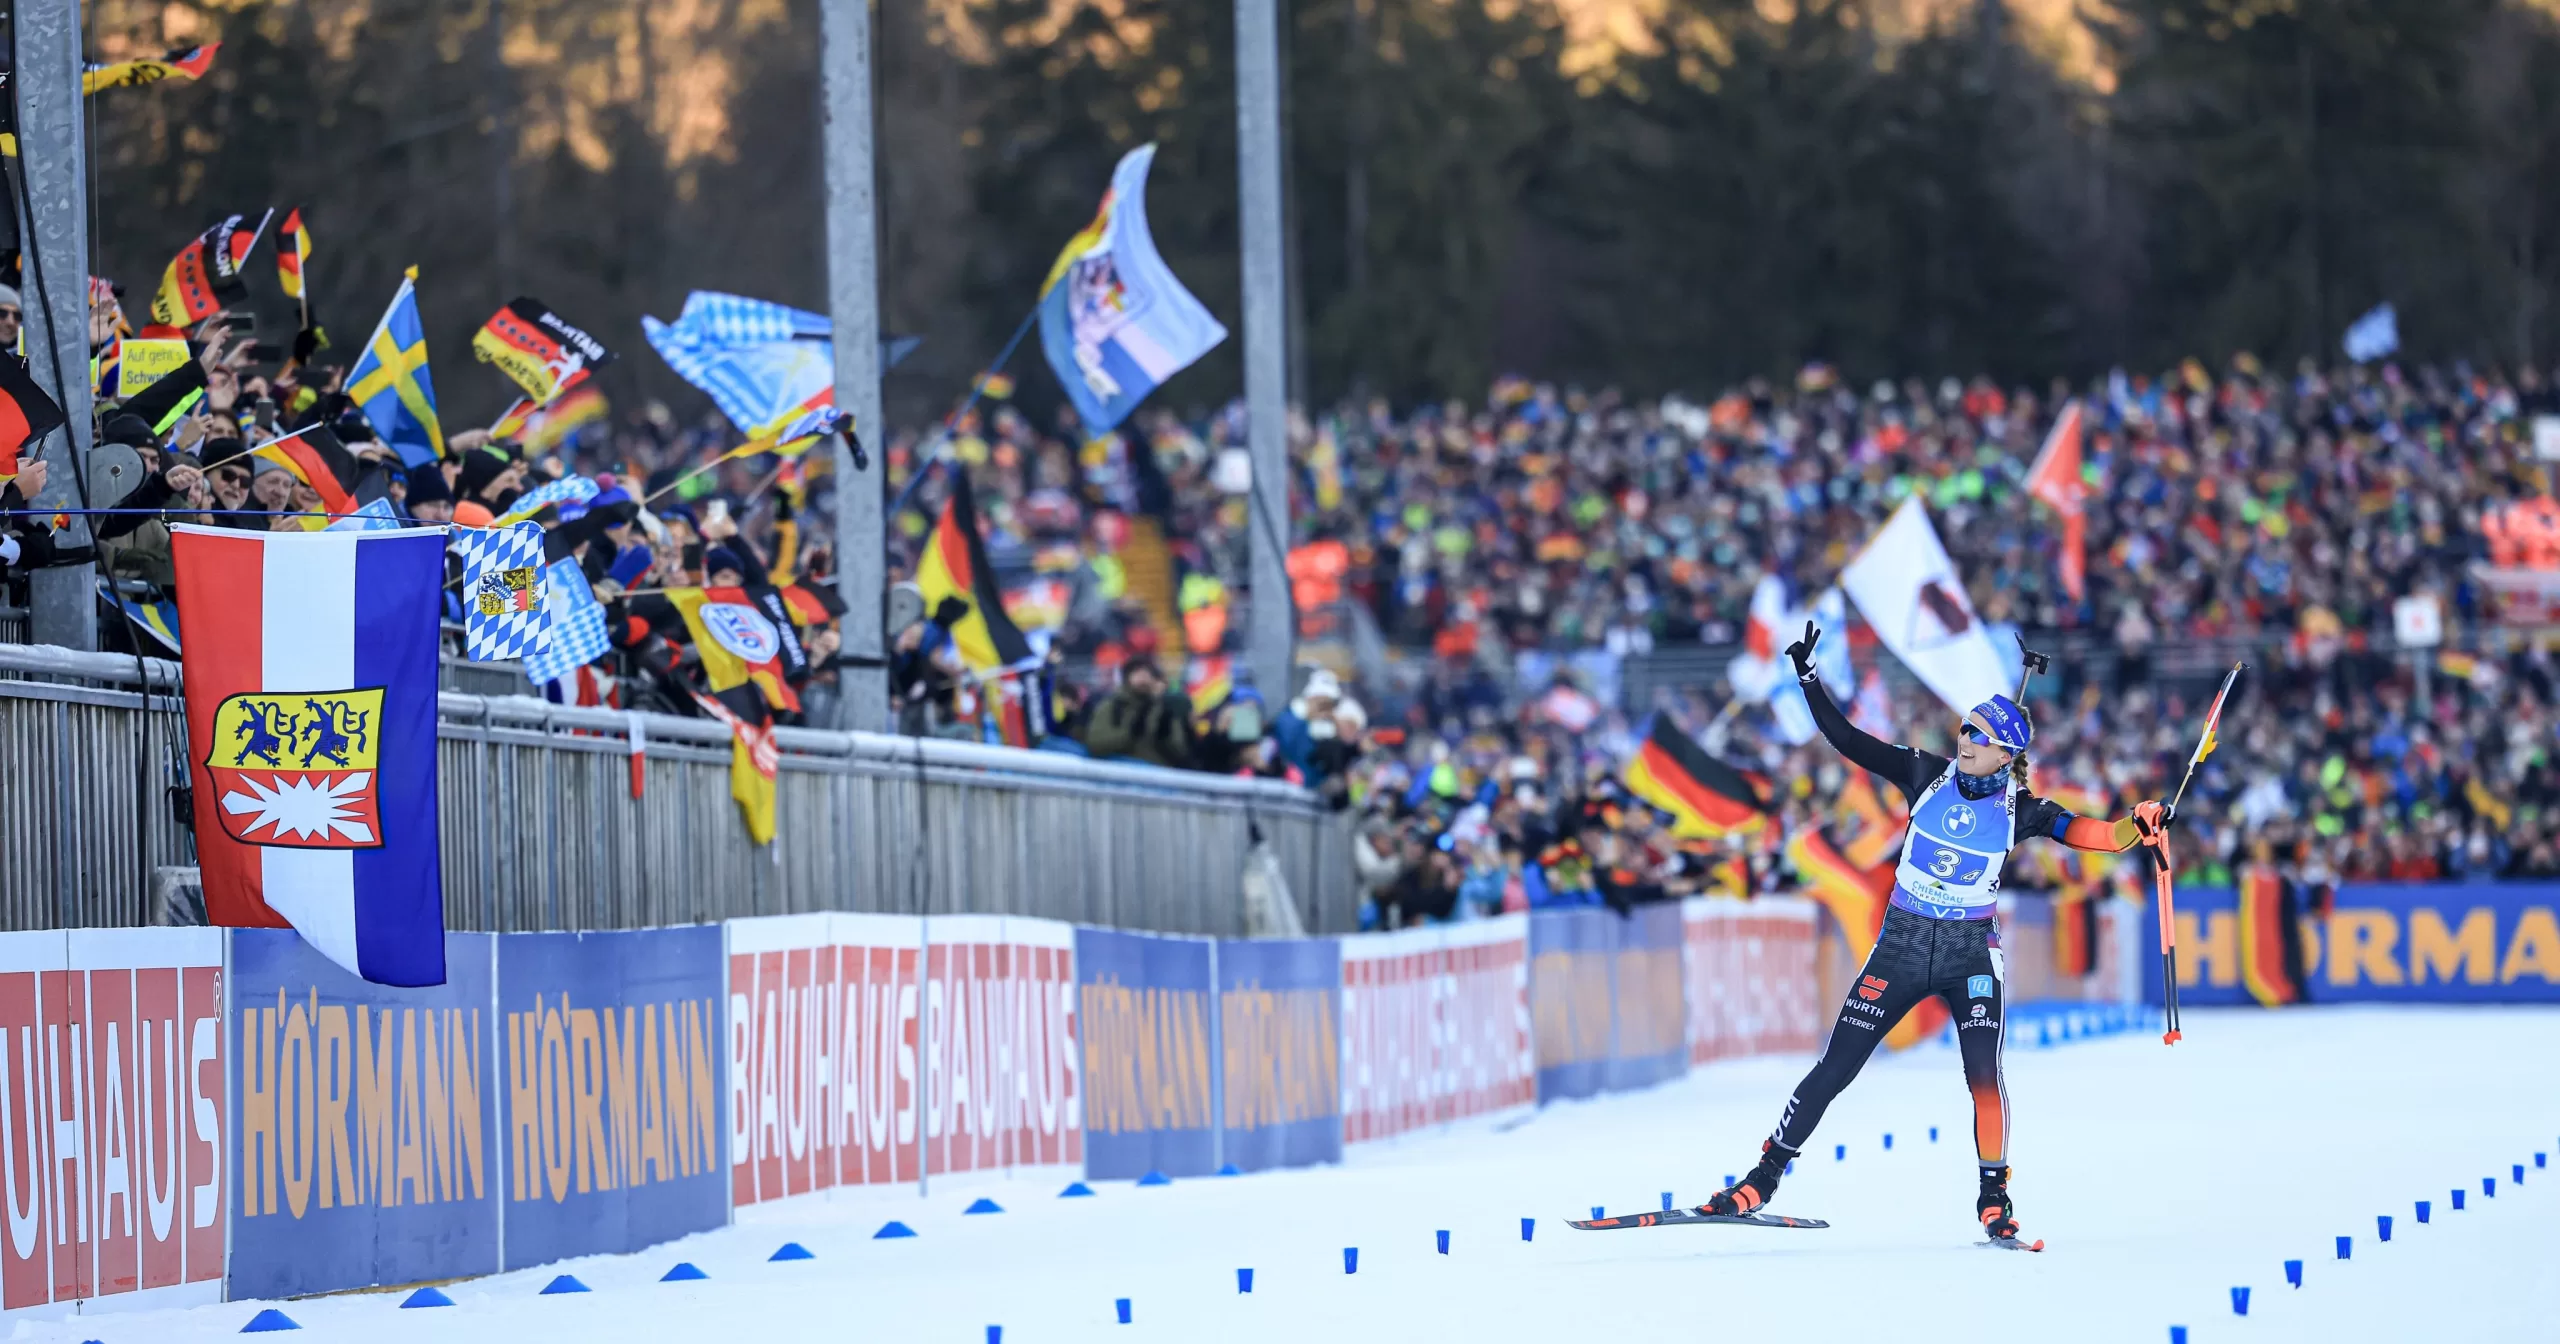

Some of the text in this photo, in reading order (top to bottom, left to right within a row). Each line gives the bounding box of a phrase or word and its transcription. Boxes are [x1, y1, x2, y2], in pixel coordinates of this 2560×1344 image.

[127, 348, 146, 362] Auf
[1929, 772, 1948, 793] JOKA
[1951, 806, 1974, 820] BMW
[2006, 794, 2016, 817] JOKA
[1928, 848, 1982, 882] 3 4
[1906, 894, 1924, 911] THE
[1912, 880, 1964, 904] CHIEMGAU
[1971, 977, 1989, 994] TQ
[1846, 998, 1886, 1018] WÜRTH
[1848, 1016, 1876, 1032] TERREX
[1960, 1017, 1999, 1031] tectake
[927, 978, 1079, 1138] BAUHAUS
[732, 982, 918, 1165] BAUHAUS
[243, 985, 484, 1220] HÖRMANN
[507, 991, 717, 1204] HÖRMANN
